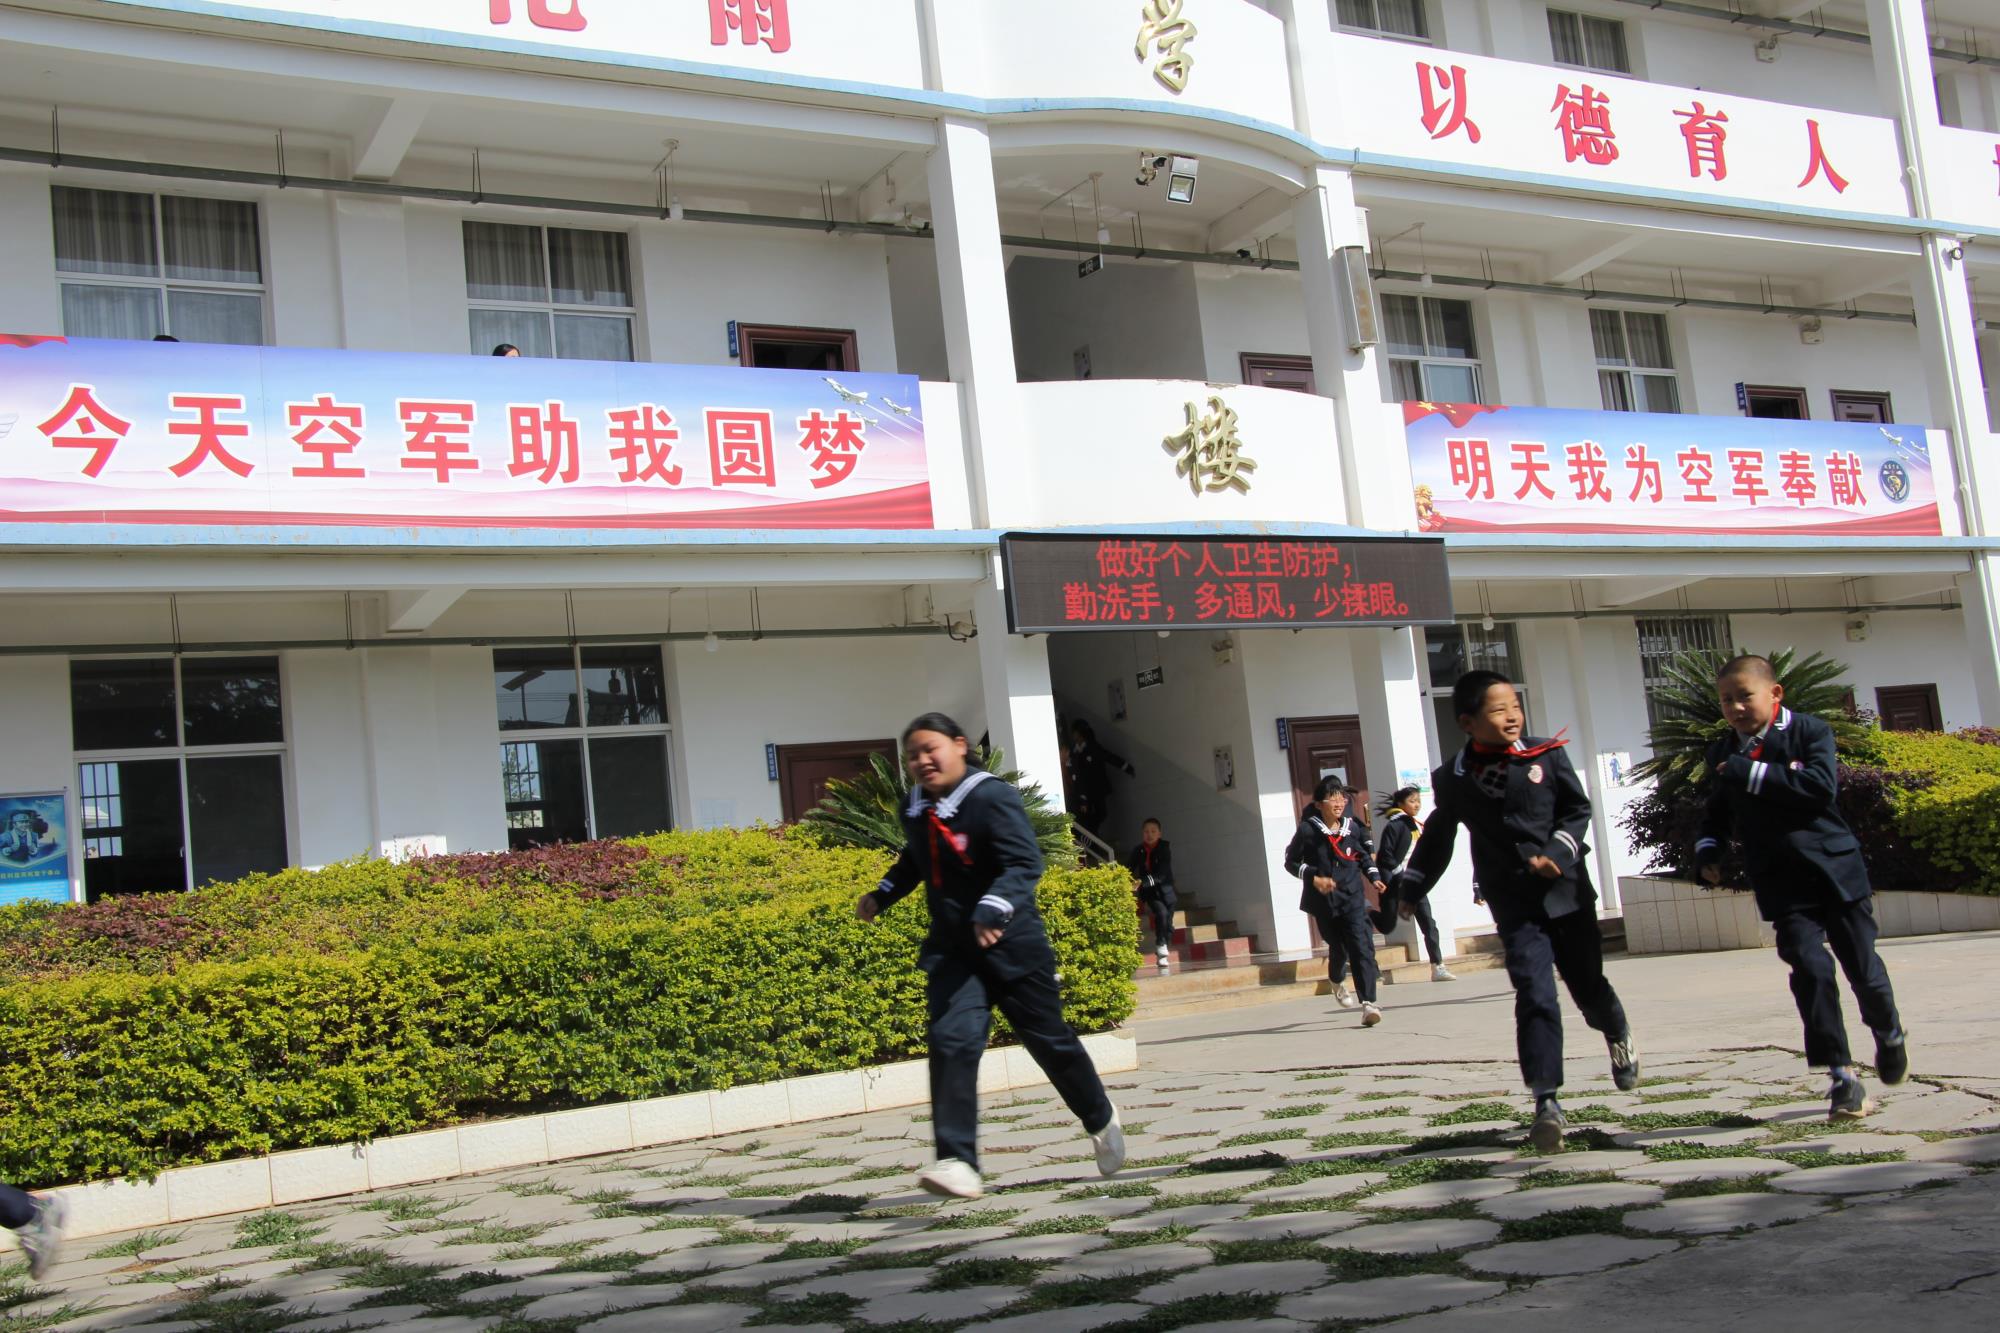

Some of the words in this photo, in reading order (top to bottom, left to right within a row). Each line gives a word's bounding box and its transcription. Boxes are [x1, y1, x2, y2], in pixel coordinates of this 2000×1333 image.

[1134, 0, 1198, 96] 学
[1416, 61, 1848, 193] 以德育人
[38, 385, 867, 490] 今天空军助我圆梦
[1161, 396, 1258, 498] 楼
[1447, 439, 1867, 506] 明天我为空军奉献
[1096, 540, 1353, 579] 做好个人卫生防护，
